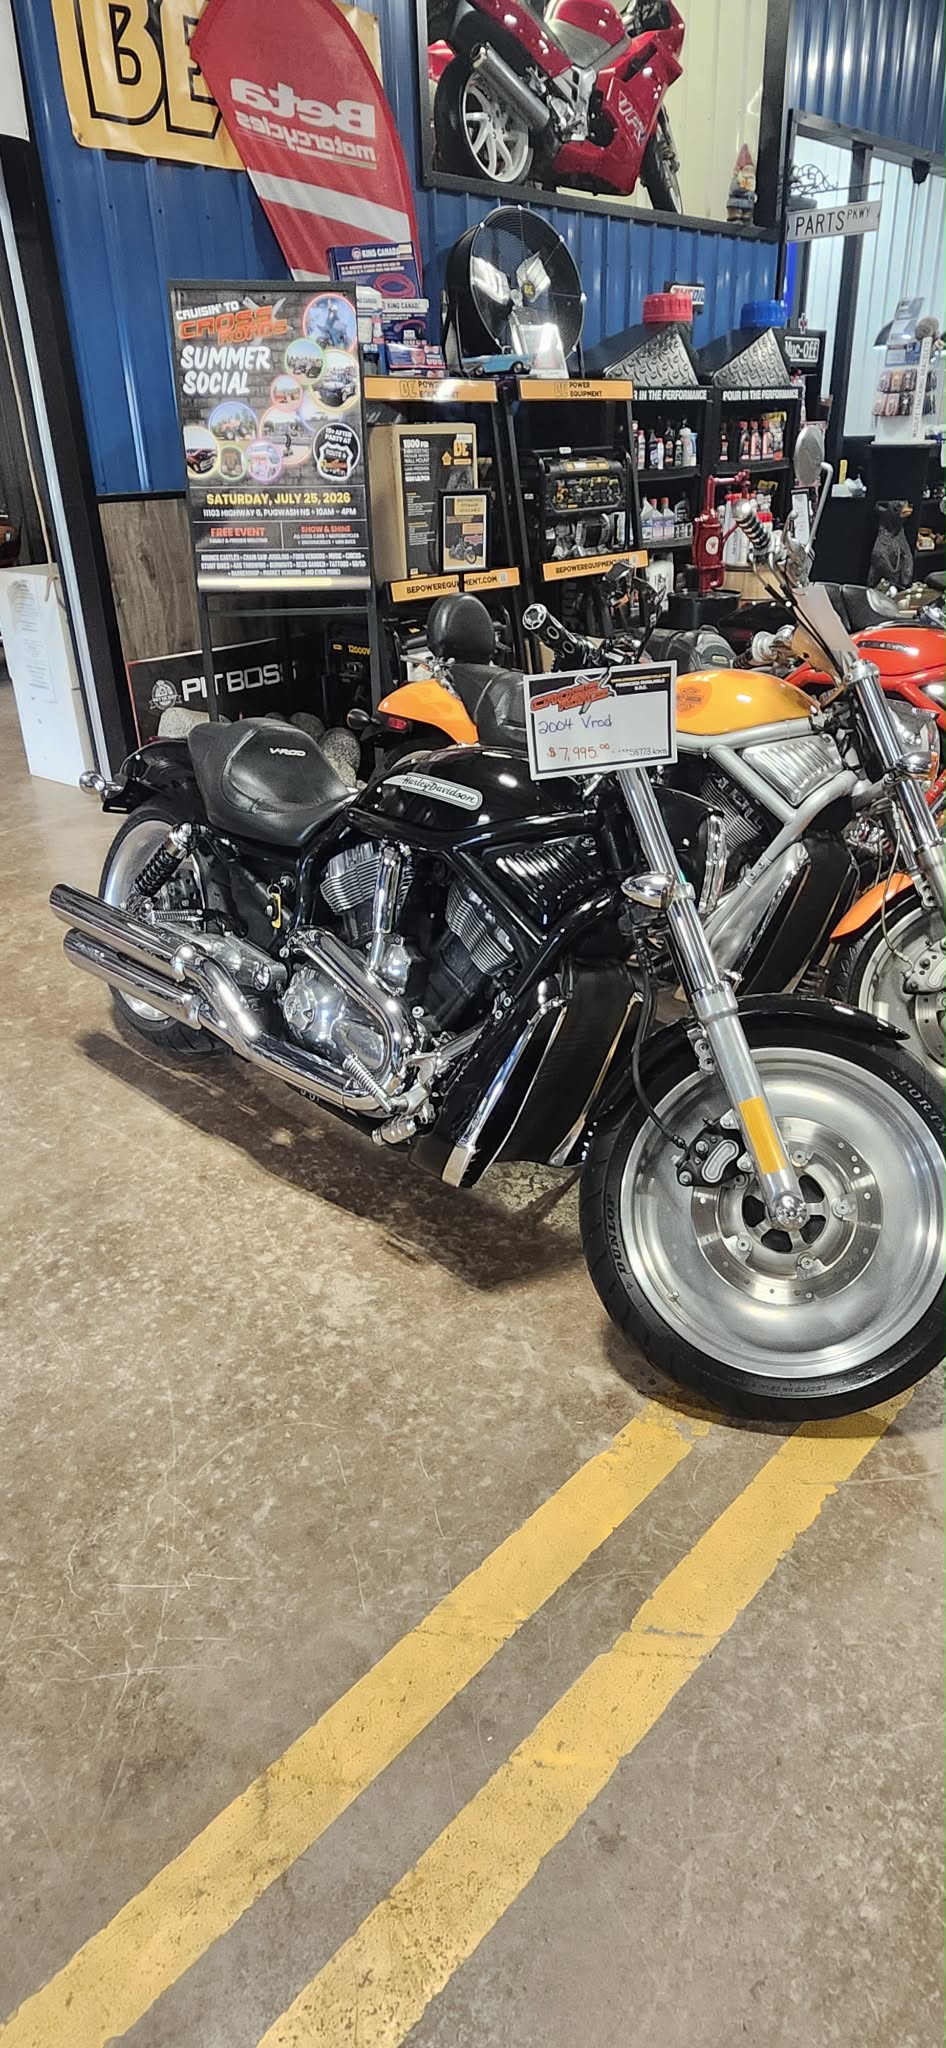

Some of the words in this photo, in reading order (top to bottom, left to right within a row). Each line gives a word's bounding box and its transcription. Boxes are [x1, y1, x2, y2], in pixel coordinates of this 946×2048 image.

[795, 210, 845, 236] PARTS
[846, 206, 871, 220] PKWY
[175, 304, 222, 320] CRUISIN'
[223, 300, 240, 312] TO
[179, 305, 273, 340] CROSS
[217, 318, 288, 346] ROADS
[180, 345, 271, 370] SUMMER
[182, 370, 251, 395] SOCIAL
[569, 381, 591, 389] POWER
[570, 390, 603, 398] EQUIPMENT
[648, 390, 661, 400] THE
[662, 390, 707, 400] PERFORMANCE
[722, 390, 742, 401] POUR
[750, 390, 761, 400] THE
[761, 389, 799, 400] PERFORMANCE
[206, 493, 272, 506] SATURDAY,
[274, 493, 302, 505] JULY
[303, 493, 321, 505] 25,
[323, 492, 351, 504] 2026
[220, 508, 254, 517] HIGHWAY
[210, 527, 234, 537] FREE
[234, 527, 265, 536] EVENT
[538, 717, 573, 735] 2004
[607, 1193, 630, 1275] DUNLOP
